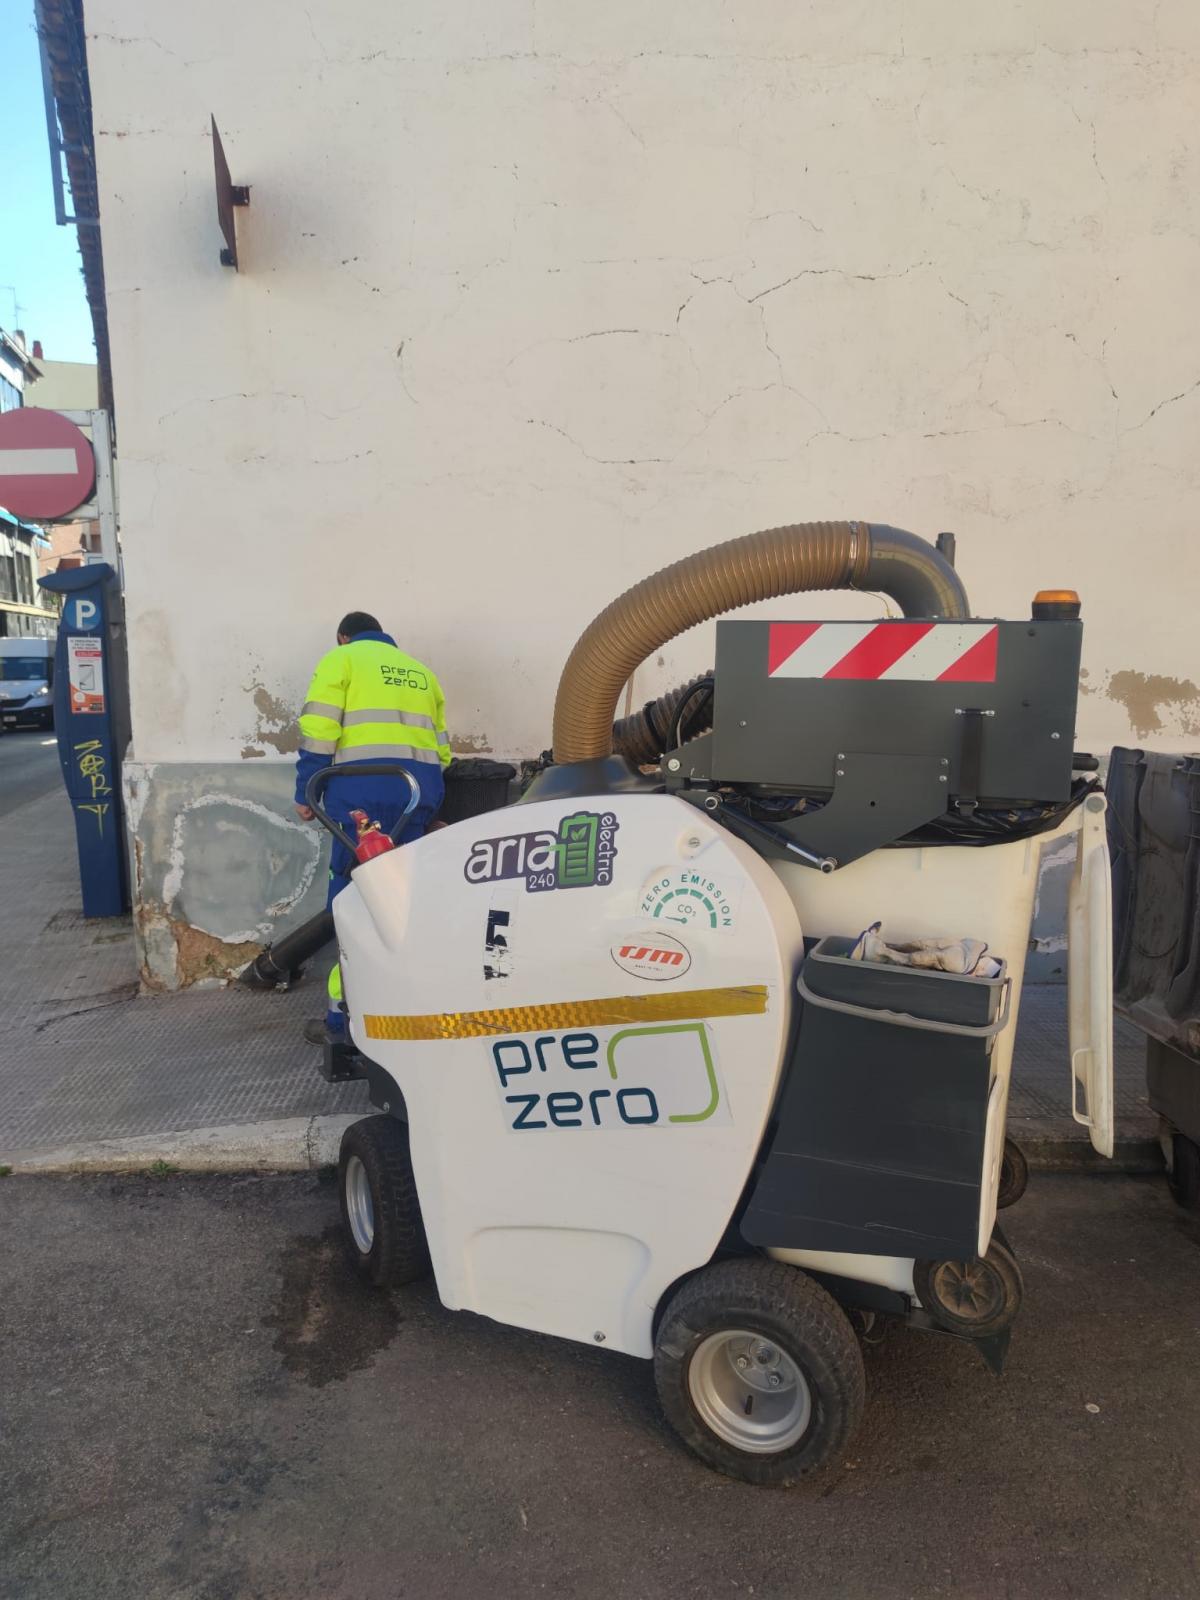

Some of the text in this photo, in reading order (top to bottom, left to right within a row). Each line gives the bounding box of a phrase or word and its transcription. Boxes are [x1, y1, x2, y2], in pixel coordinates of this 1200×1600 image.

[75, 600, 96, 630] P
[380, 665, 406, 675] pre
[383, 676, 418, 689] zero
[466, 834, 557, 881] aria
[597, 815, 616, 882] electric
[529, 873, 555, 889] 240
[641, 873, 732, 926] ZERO EMISSION
[492, 1033, 599, 1087] pre
[505, 1087, 659, 1130] zero
